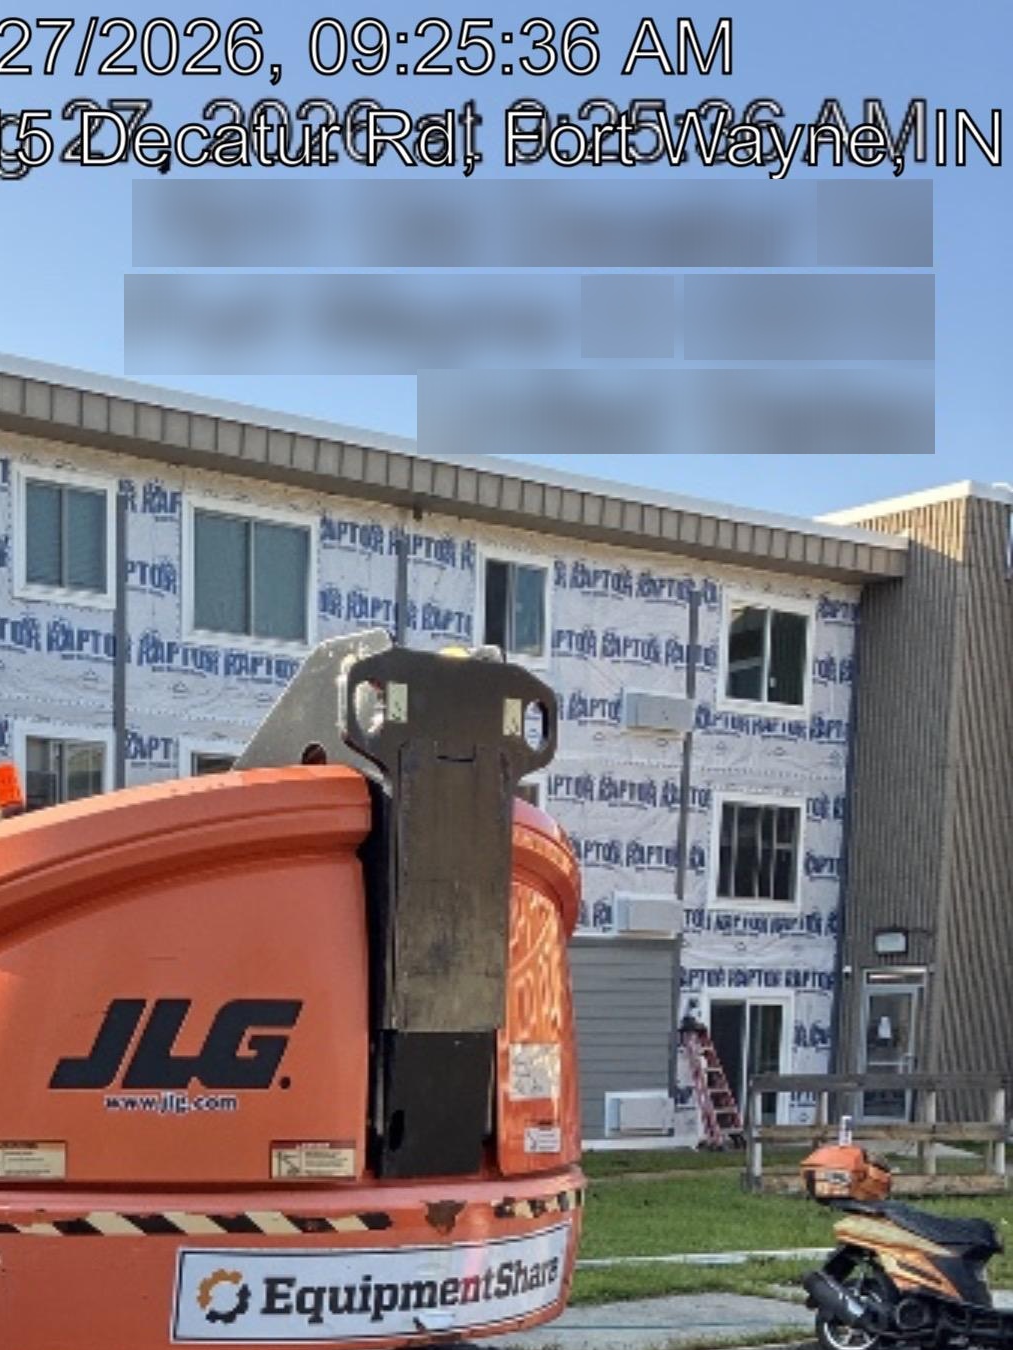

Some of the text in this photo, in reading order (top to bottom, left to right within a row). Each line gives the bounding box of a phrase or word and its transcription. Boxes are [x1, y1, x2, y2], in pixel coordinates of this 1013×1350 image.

[389, 526, 456, 568] RPTOR
[138, 632, 219, 677] RAPTOR
[49, 999, 303, 1089] JLG
[104, 1092, 238, 1116] www.jlg.com
[260, 1254, 560, 1324] EquipmentShare
